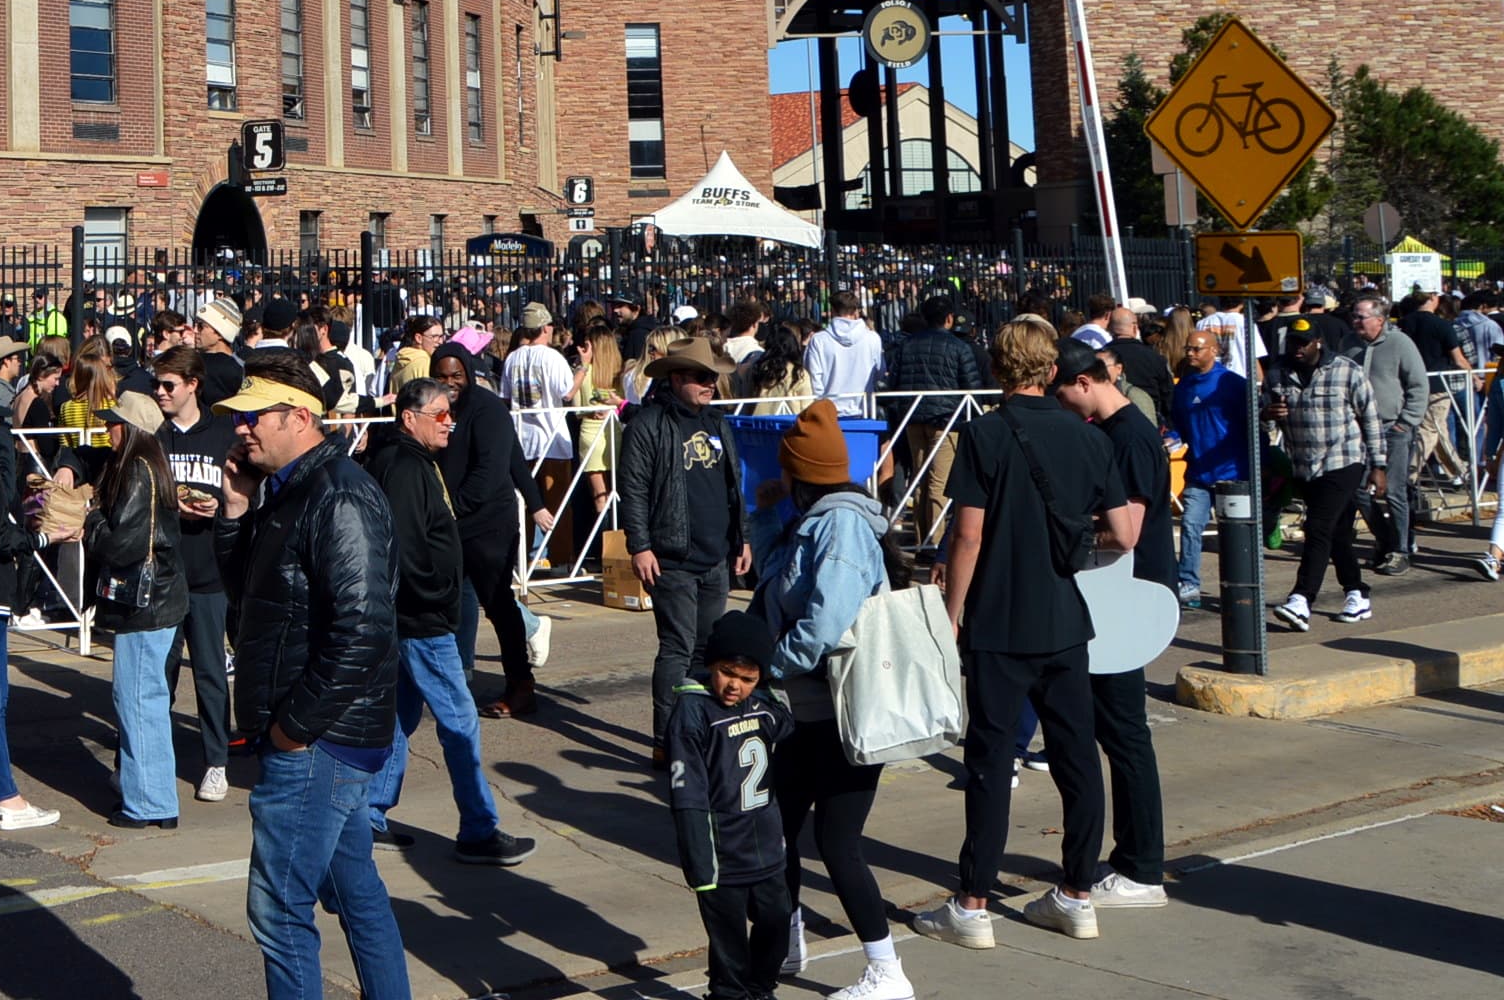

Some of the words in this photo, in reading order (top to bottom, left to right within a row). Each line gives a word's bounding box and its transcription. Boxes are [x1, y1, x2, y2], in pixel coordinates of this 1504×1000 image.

[887, 61, 912, 69] FIELD
[253, 125, 272, 133] GATE
[253, 133, 273, 169] 5
[573, 184, 587, 204] 6
[702, 187, 750, 200] BUFFS
[736, 200, 760, 208] STORE
[494, 239, 522, 251] Modelo
[169, 453, 200, 462] ERSITY
[203, 455, 214, 463] OF
[728, 718, 760, 737] COLORADO
[671, 760, 686, 789] 2
[738, 736, 769, 811] 2
